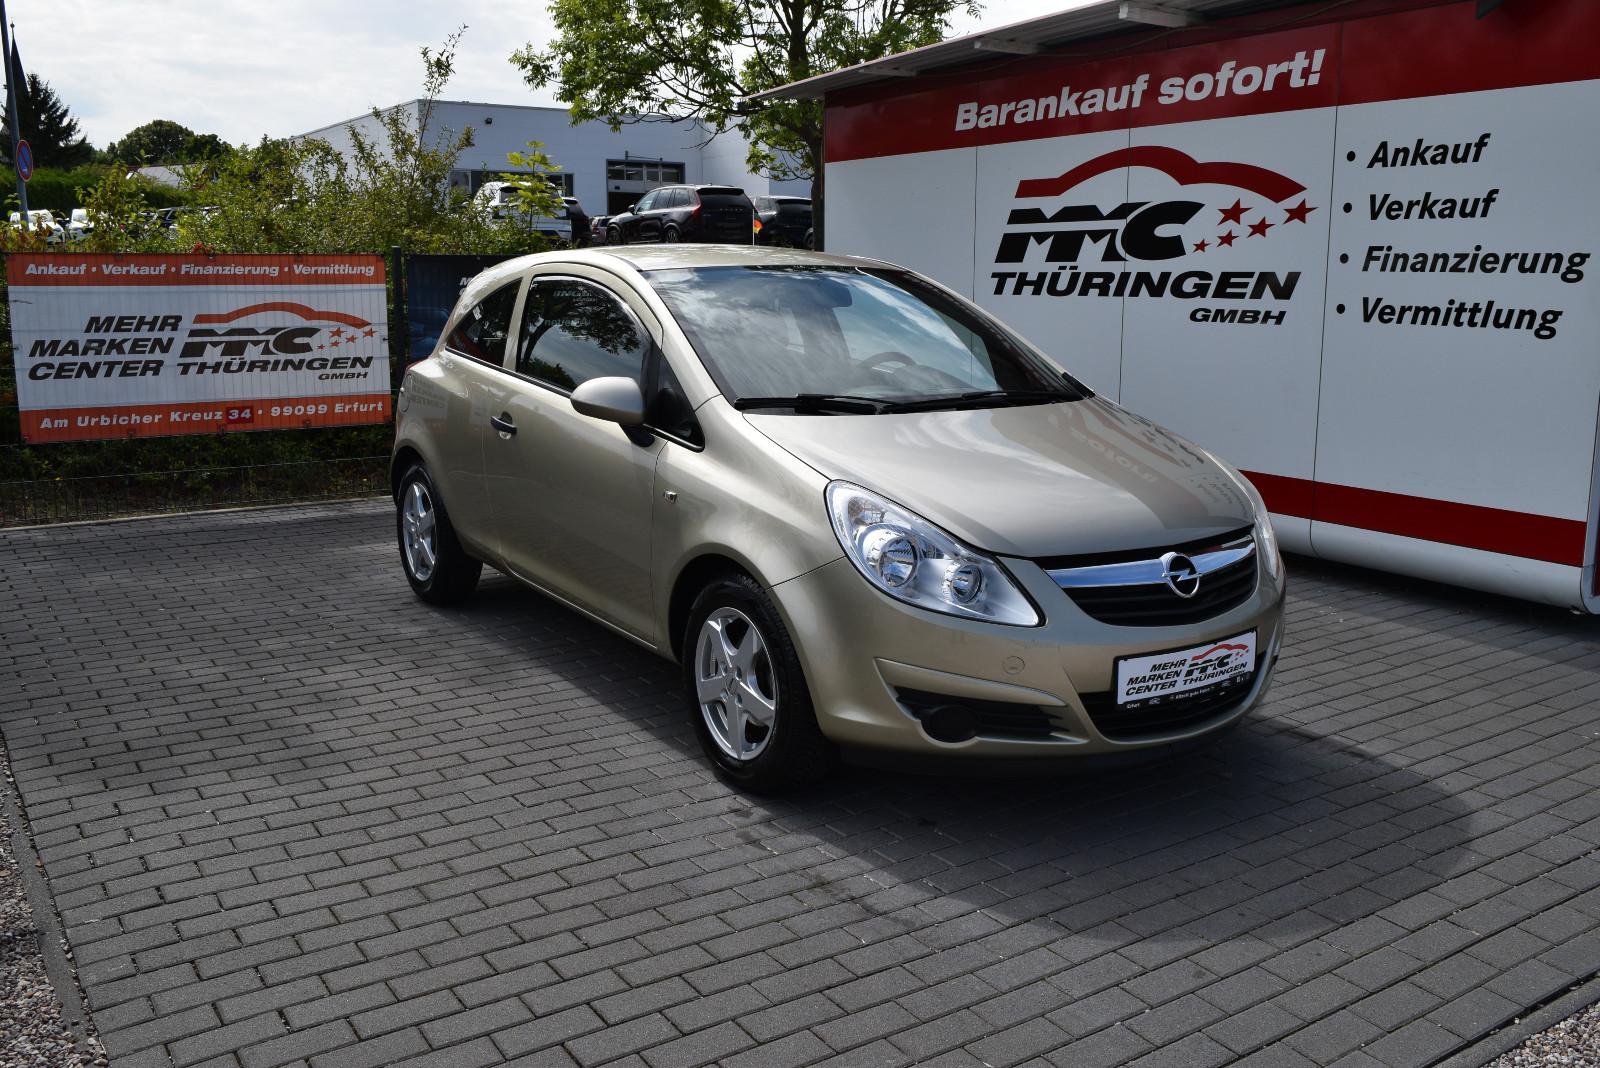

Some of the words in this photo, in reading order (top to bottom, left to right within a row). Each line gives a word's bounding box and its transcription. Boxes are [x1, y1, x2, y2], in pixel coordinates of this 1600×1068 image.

[954, 74, 1150, 132] Barankauf
[1157, 49, 1327, 105] sofort!
[1366, 132, 1491, 169] Ankauf
[1369, 188, 1499, 220] Verkauf
[994, 200, 1206, 264] MMC
[25, 263, 87, 276] Ankauf
[102, 263, 167, 276] Verkauf
[181, 263, 279, 277] Finanzierung
[293, 263, 375, 277] Vermittlung
[1362, 244, 1591, 284] Finanzierung
[989, 265, 1302, 301] THÜRINGEN
[83, 315, 183, 334] MEHR
[1189, 307, 1287, 326] GMBH
[1362, 297, 1564, 340] Vermittlung
[28, 337, 175, 357] MARKEN
[179, 327, 322, 359] MMC
[28, 359, 165, 381] CENTER
[176, 355, 374, 376] THÜRINGEN
[318, 372, 369, 381] GMBH
[40, 416, 70, 429] Am
[76, 412, 162, 428] Urbicher
[170, 410, 223, 423] Kreuz
[228, 408, 251, 420] 34
[270, 403, 328, 417] 99099
[334, 400, 384, 414] Erfurt
[1150, 658, 1187, 673] MEHR
[1183, 661, 1248, 686] THÜRINGEN
[1125, 679, 1178, 696] CENTER
[1127, 669, 1182, 686] MARKEN
